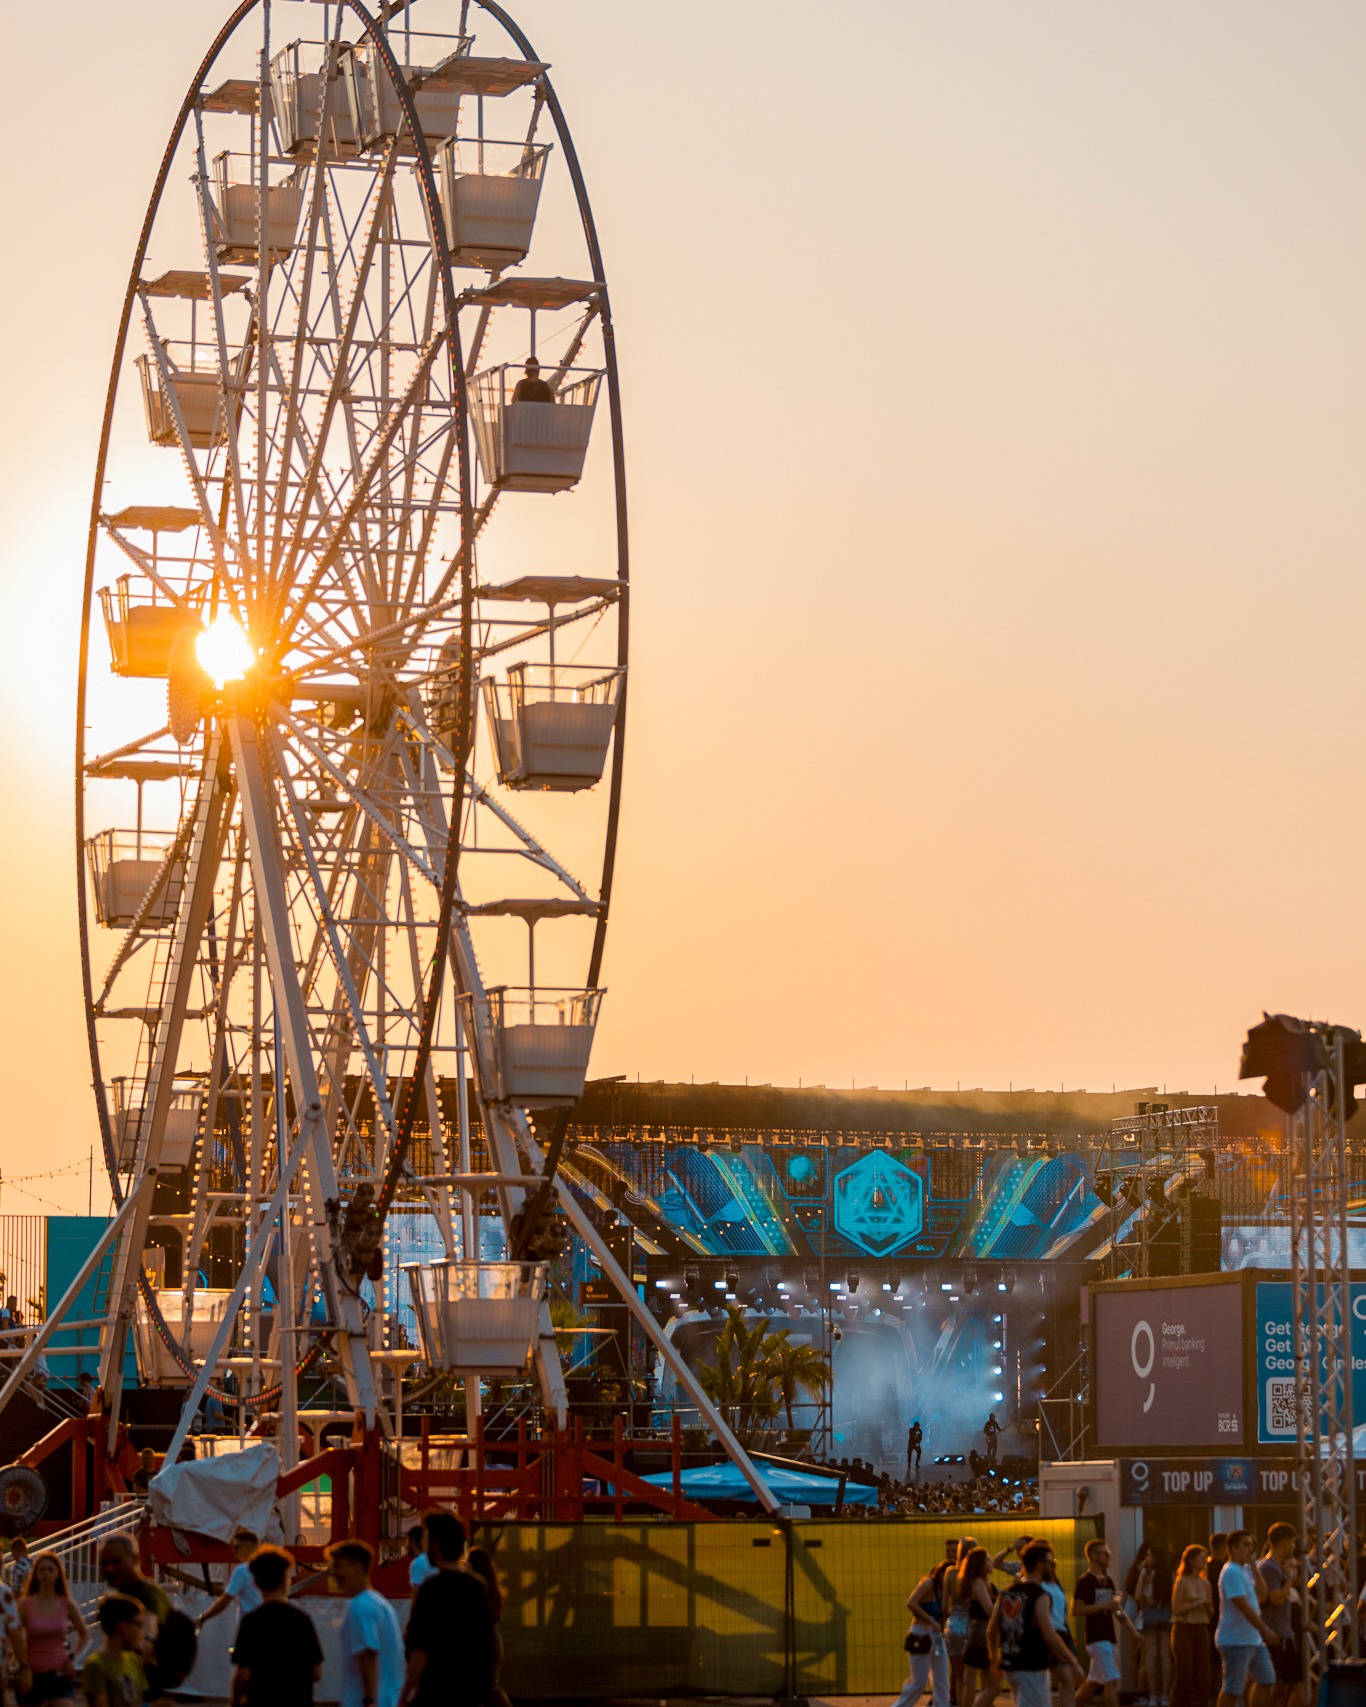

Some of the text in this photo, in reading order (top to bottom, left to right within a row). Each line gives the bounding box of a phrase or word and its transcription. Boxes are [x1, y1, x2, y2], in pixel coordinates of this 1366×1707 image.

[1161, 1322, 1187, 1337] George.
[1265, 1321, 1291, 1335] Get
[1162, 1337, 1205, 1353] Primul banking
[1265, 1339, 1291, 1352] Get
[1162, 1354, 1191, 1370] inteligent.
[1265, 1356, 1313, 1374] Geog
[1218, 1420, 1231, 1432] BCR
[1161, 1471, 1191, 1492] TOP
[1193, 1470, 1214, 1492] UP
[1259, 1471, 1288, 1491] TOP
